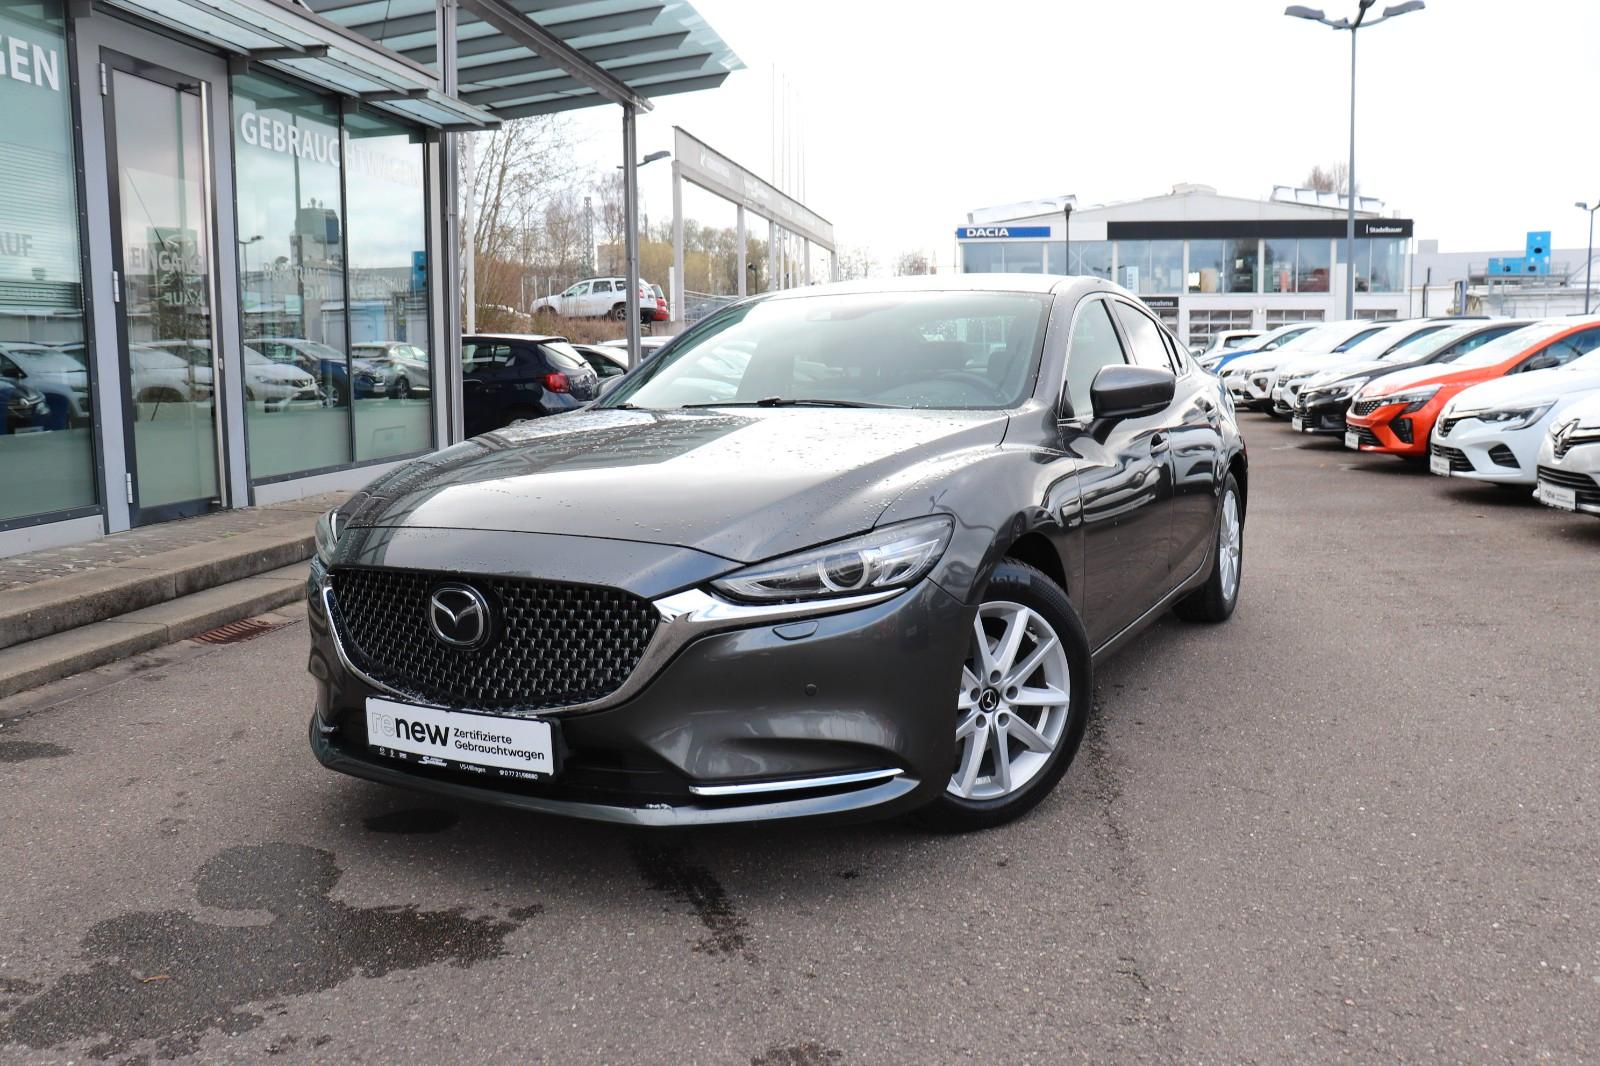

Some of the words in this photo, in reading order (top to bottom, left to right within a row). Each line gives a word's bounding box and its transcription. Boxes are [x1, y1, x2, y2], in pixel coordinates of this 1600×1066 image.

[0, 33, 60, 92] EN
[966, 228, 1009, 237] DACIA
[371, 712, 450, 747] renew
[453, 728, 513, 744] Zertifizierte
[454, 740, 545, 761] Gebrauchtwagen
